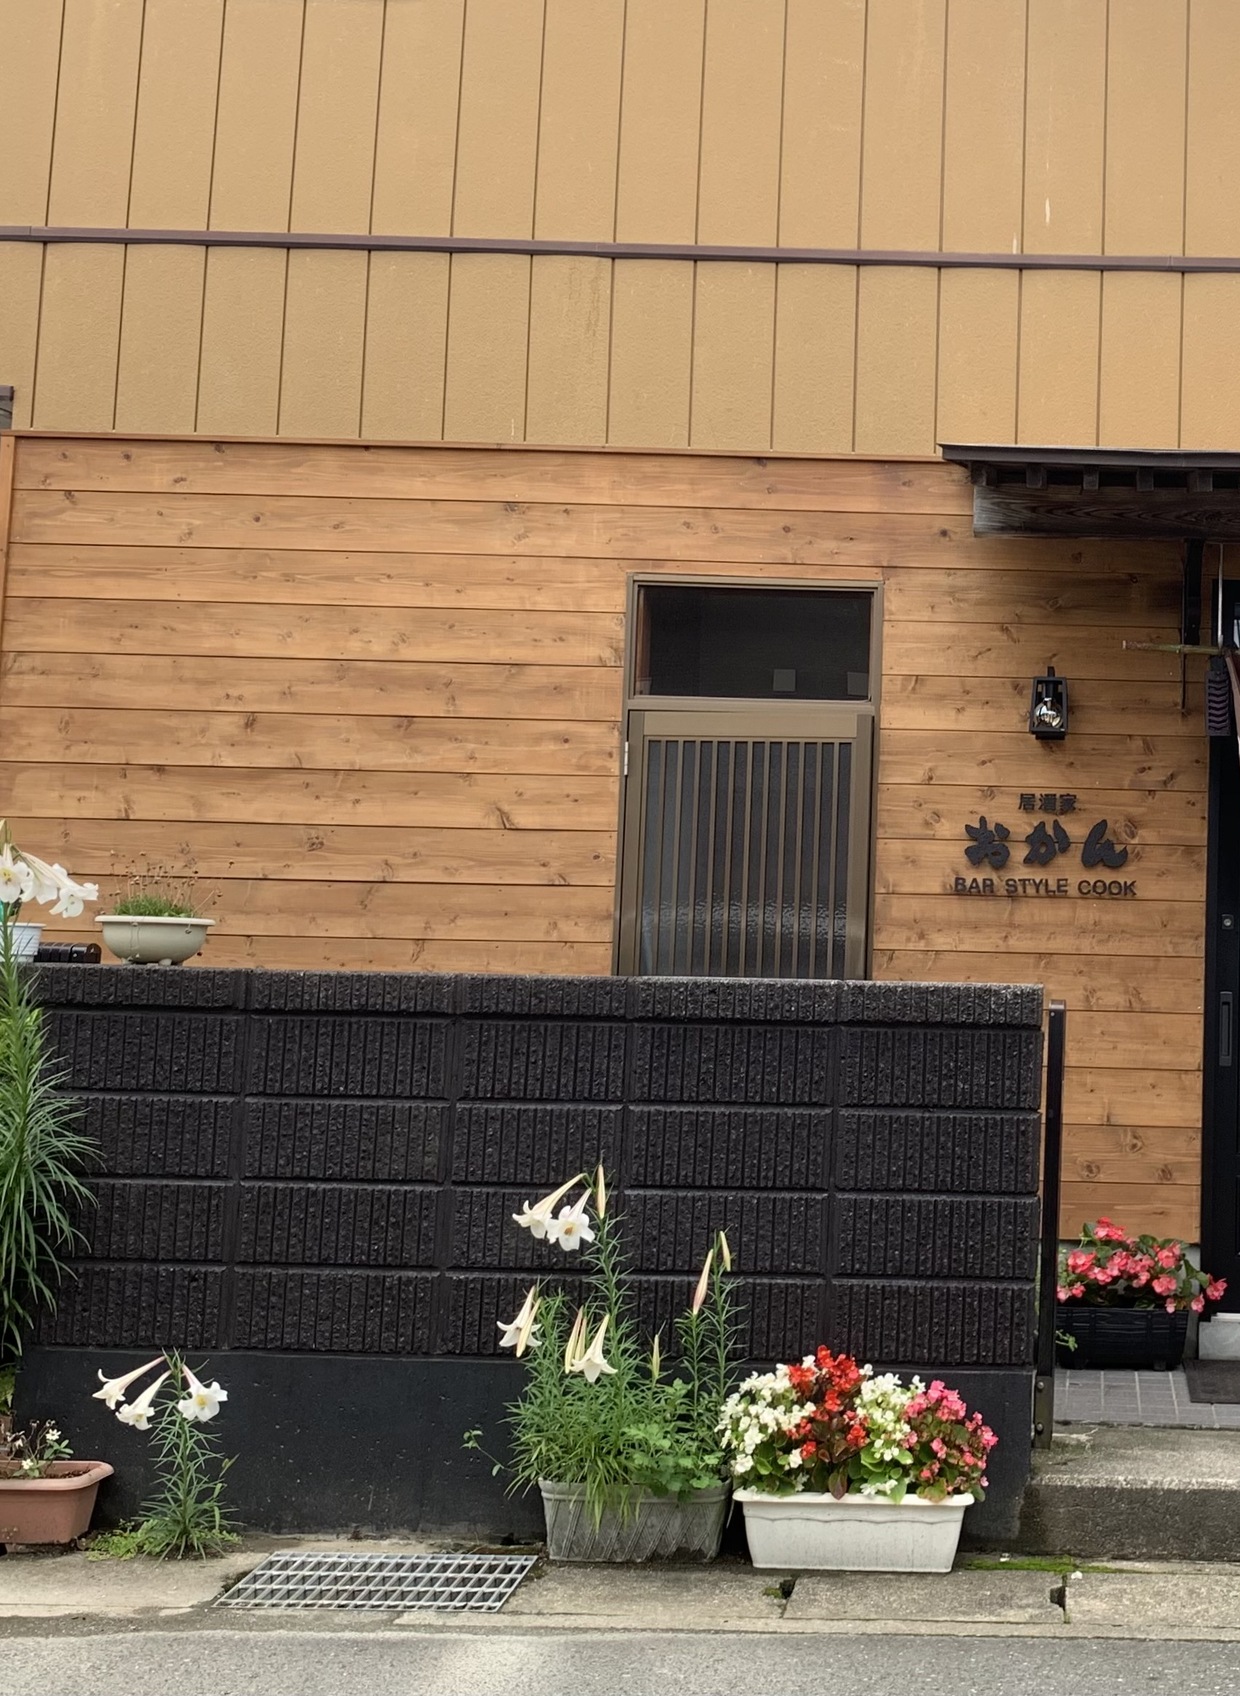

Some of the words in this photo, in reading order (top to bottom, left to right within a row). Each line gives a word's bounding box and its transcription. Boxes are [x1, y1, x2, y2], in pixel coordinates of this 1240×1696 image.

[1018, 793, 1078, 812] 居酒家
[964, 815, 1129, 869] おかん
[953, 876, 995, 894] BAR
[1005, 878, 1069, 895] STYLE
[1077, 880, 1137, 897] COOK
